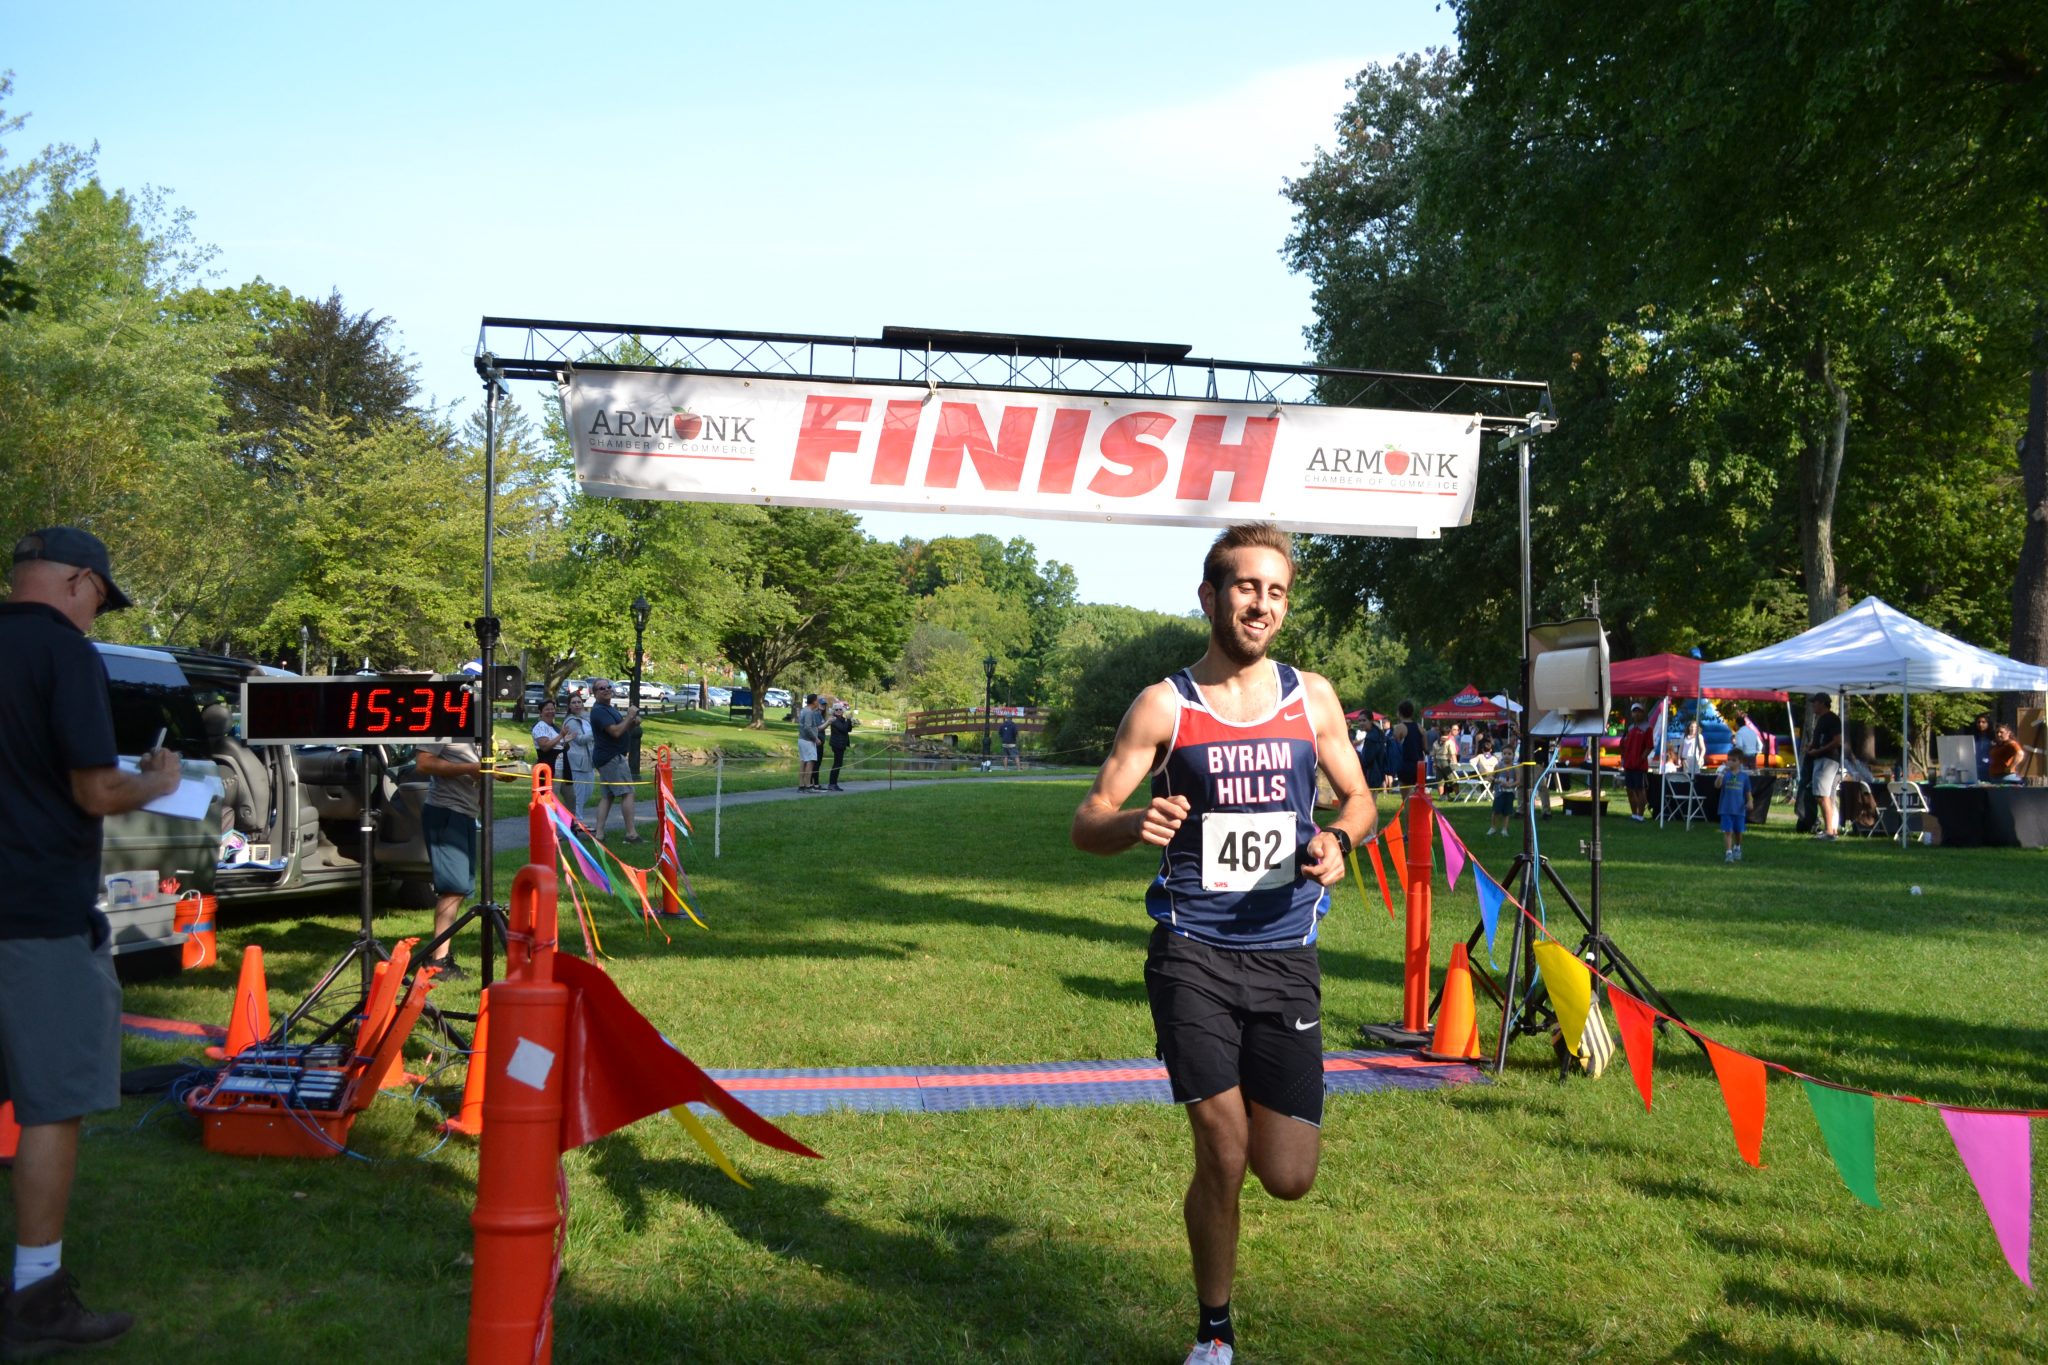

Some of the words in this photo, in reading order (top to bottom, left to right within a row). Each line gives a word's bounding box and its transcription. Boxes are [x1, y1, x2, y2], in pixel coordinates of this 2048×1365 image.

[588, 409, 755, 442] ARMONK
[589, 438, 650, 449] CHAMBER
[682, 444, 756, 454] COMMERCE
[790, 395, 1280, 503] FINISH
[1305, 447, 1459, 478] ARMONK
[1305, 476, 1362, 485] CHAMBER
[1369, 478, 1384, 486] OF
[347, 689, 470, 732] 15:34
[1207, 742, 1292, 774] BYRAM
[1217, 774, 1287, 805] HILLS
[1218, 830, 1282, 871] 462
